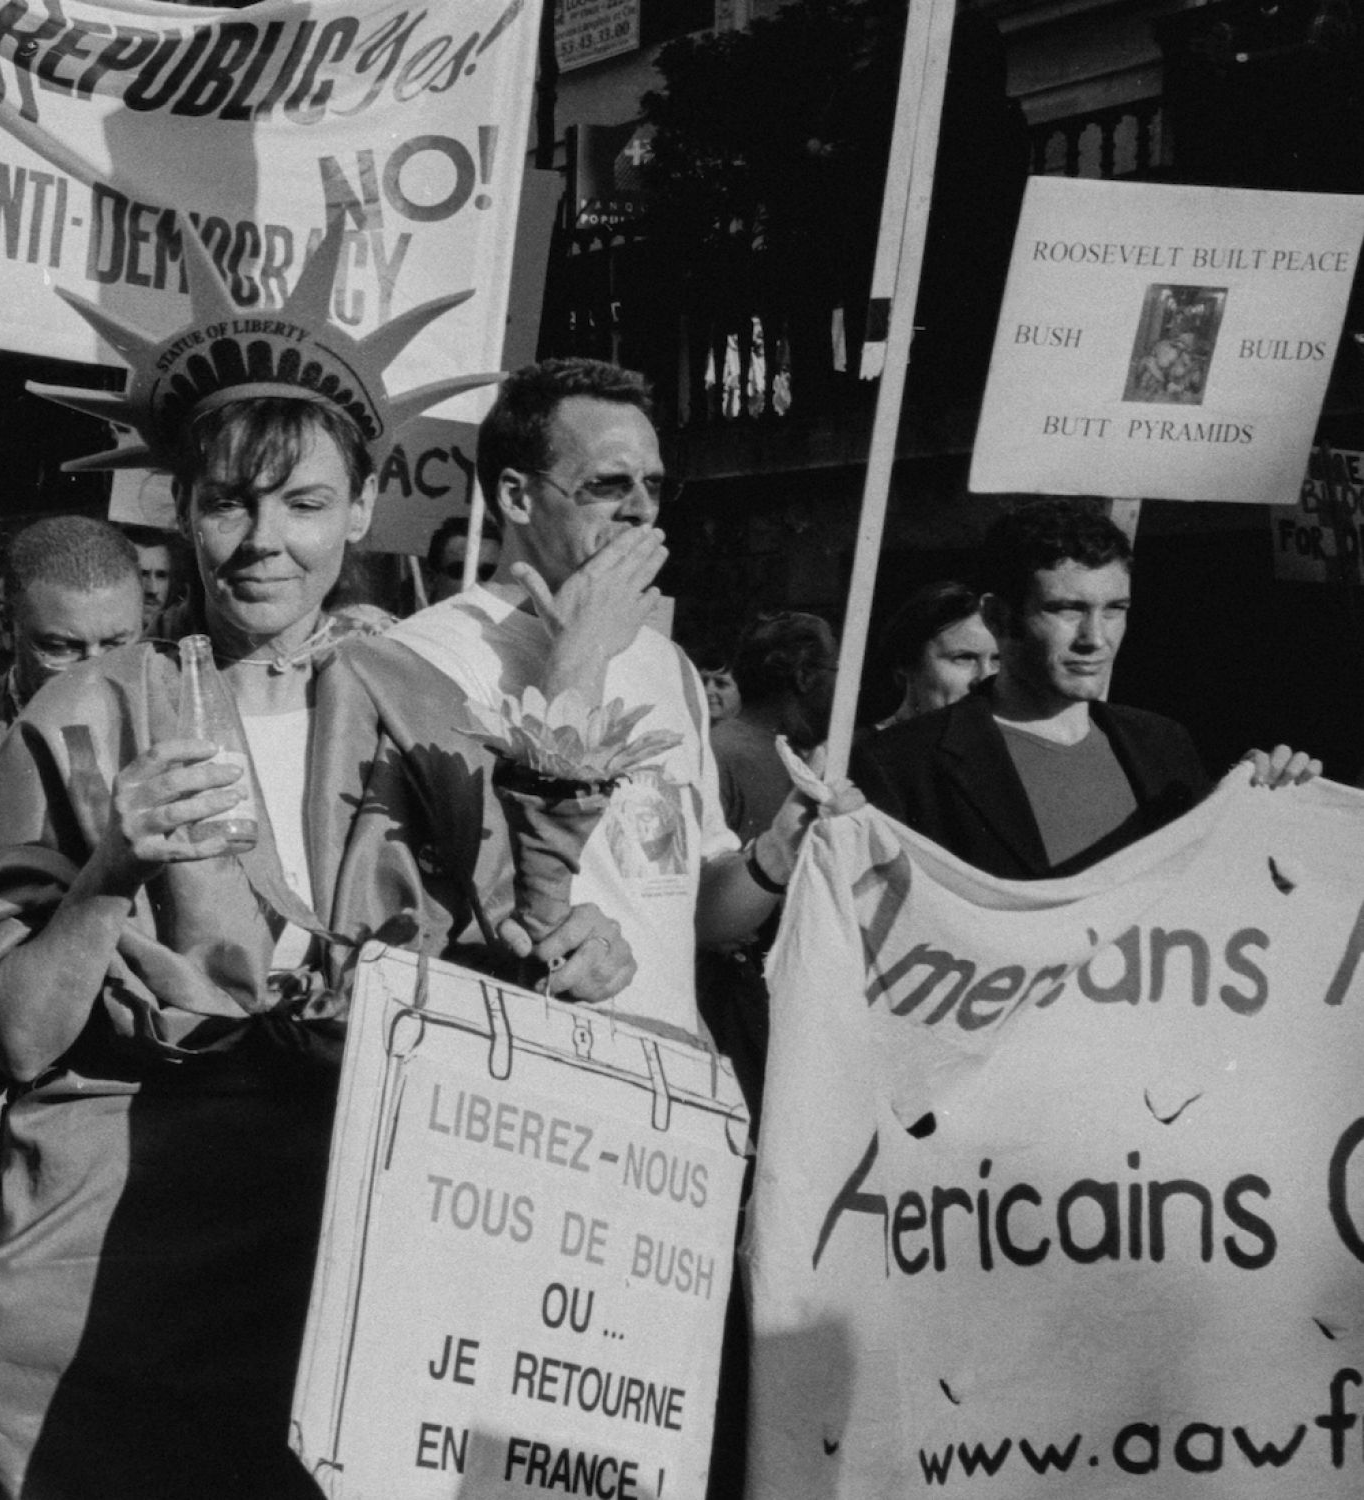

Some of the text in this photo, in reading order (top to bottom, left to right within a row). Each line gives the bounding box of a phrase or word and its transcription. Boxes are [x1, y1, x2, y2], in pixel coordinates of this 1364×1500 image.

[337, 0, 524, 118] Yes!
[319, 126, 499, 230] NO!
[1032, 239, 1349, 273] ROOSEVELT BUILT PEACE
[156, 319, 310, 372] STATUE OF LIBERTY
[1014, 324, 1327, 361] BUSH BUILDS
[1043, 416, 1255, 445] BUTT PYRAMIDS
[427, 1083, 709, 1209] LIBEREZ-NOUS
[427, 1174, 715, 1300] TOUS DE BUSH
[428, 1334, 686, 1430] JE RETOURNE
[918, 1366, 1364, 1485] www.aawf
[415, 1422, 470, 1475] EN
[503, 1437, 639, 1500] FRANCE
